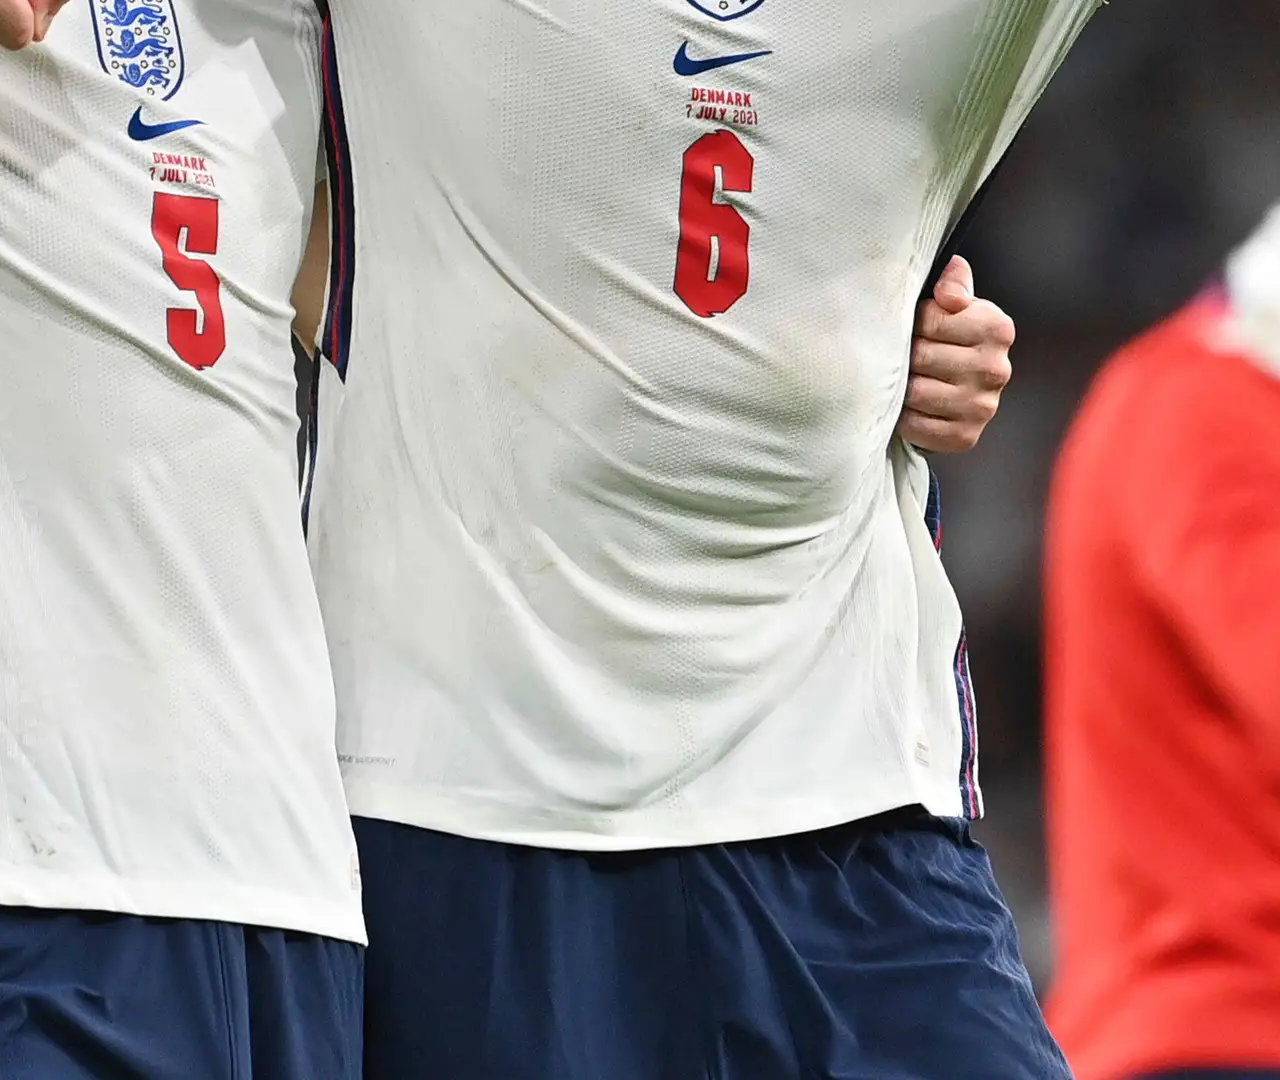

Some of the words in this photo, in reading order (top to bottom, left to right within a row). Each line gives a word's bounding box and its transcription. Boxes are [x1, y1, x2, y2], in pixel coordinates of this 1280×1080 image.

[691, 87, 752, 107] DENMARK
[685, 104, 693, 119] 7
[695, 106, 727, 121] JULY
[733, 109, 758, 125] 2021
[152, 151, 208, 171] DENMARK
[149, 167, 156, 181] 7
[160, 167, 188, 183] JULY
[673, 129, 754, 318] 6
[151, 191, 226, 371] 5
